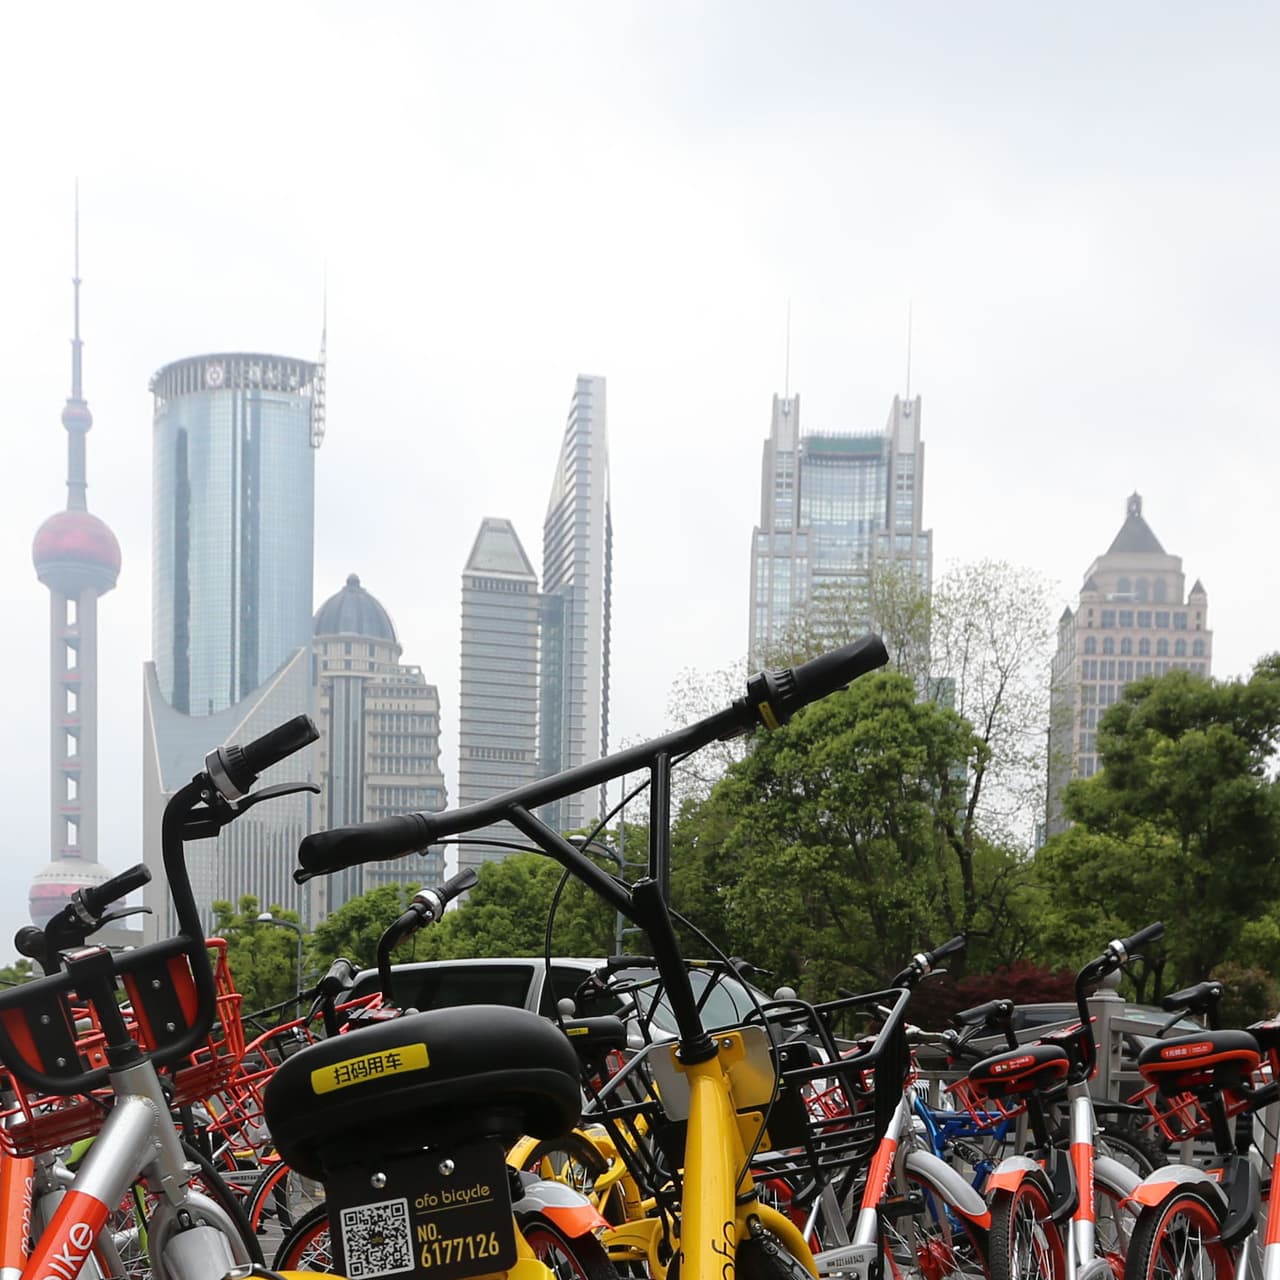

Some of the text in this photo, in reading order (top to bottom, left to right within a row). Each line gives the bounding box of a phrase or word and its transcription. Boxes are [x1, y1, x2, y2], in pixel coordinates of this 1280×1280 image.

[333, 1052, 403, 1085] 扫码用车
[415, 1183, 491, 1210] ofo bicycle
[417, 1223, 442, 1243] NO.
[421, 1231, 500, 1268] 6177126
